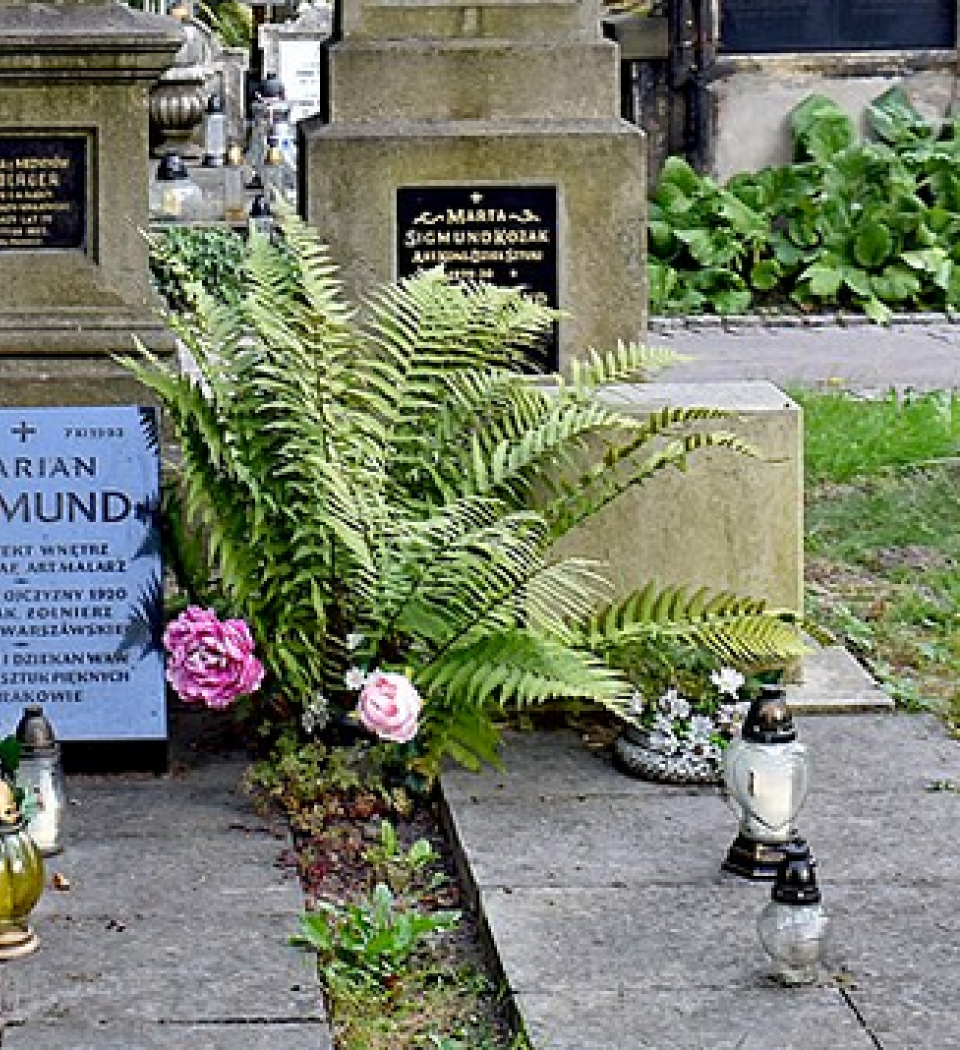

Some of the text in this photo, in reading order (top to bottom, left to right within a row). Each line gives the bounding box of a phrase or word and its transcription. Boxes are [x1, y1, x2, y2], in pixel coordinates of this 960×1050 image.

[40, 543, 110, 560] WNĘTRZ
[3, 588, 84, 603] OJCZYZNY
[88, 586, 128, 600] 1920
[26, 605, 113, 620] ŻOŁNIERZ
[13, 652, 85, 665] DZIEKAN
[1, 671, 50, 685] SZTUK
[52, 670, 130, 687] PIĘKNYCH
